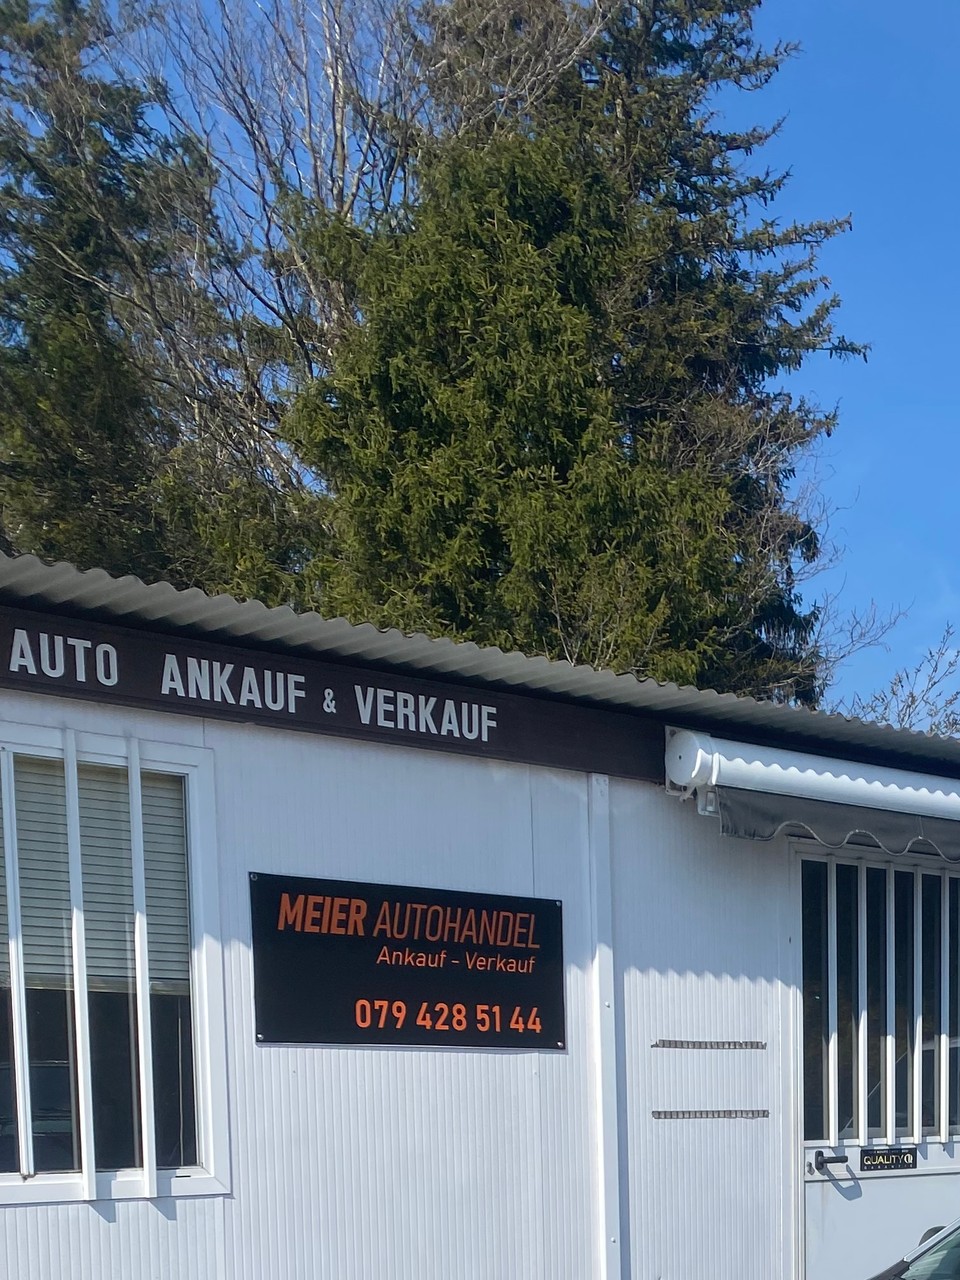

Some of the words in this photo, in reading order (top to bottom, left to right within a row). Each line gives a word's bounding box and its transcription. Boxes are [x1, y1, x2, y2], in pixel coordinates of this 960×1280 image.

[9, 628, 119, 687] AUTO
[160, 653, 306, 713] ANKAUF
[322, 687, 338, 714] &
[353, 684, 498, 743] VERKAUF
[277, 893, 367, 937] MEIER
[372, 901, 541, 949] AUTOHANDEL
[375, 945, 447, 969] Ankauf
[464, 951, 536, 974] Verkauf
[354, 998, 407, 1030] 079
[415, 1002, 467, 1032] 428
[475, 1004, 501, 1033] 51
[509, 1006, 543, 1034] 44
[863, 1154, 903, 1165] QUALITY
